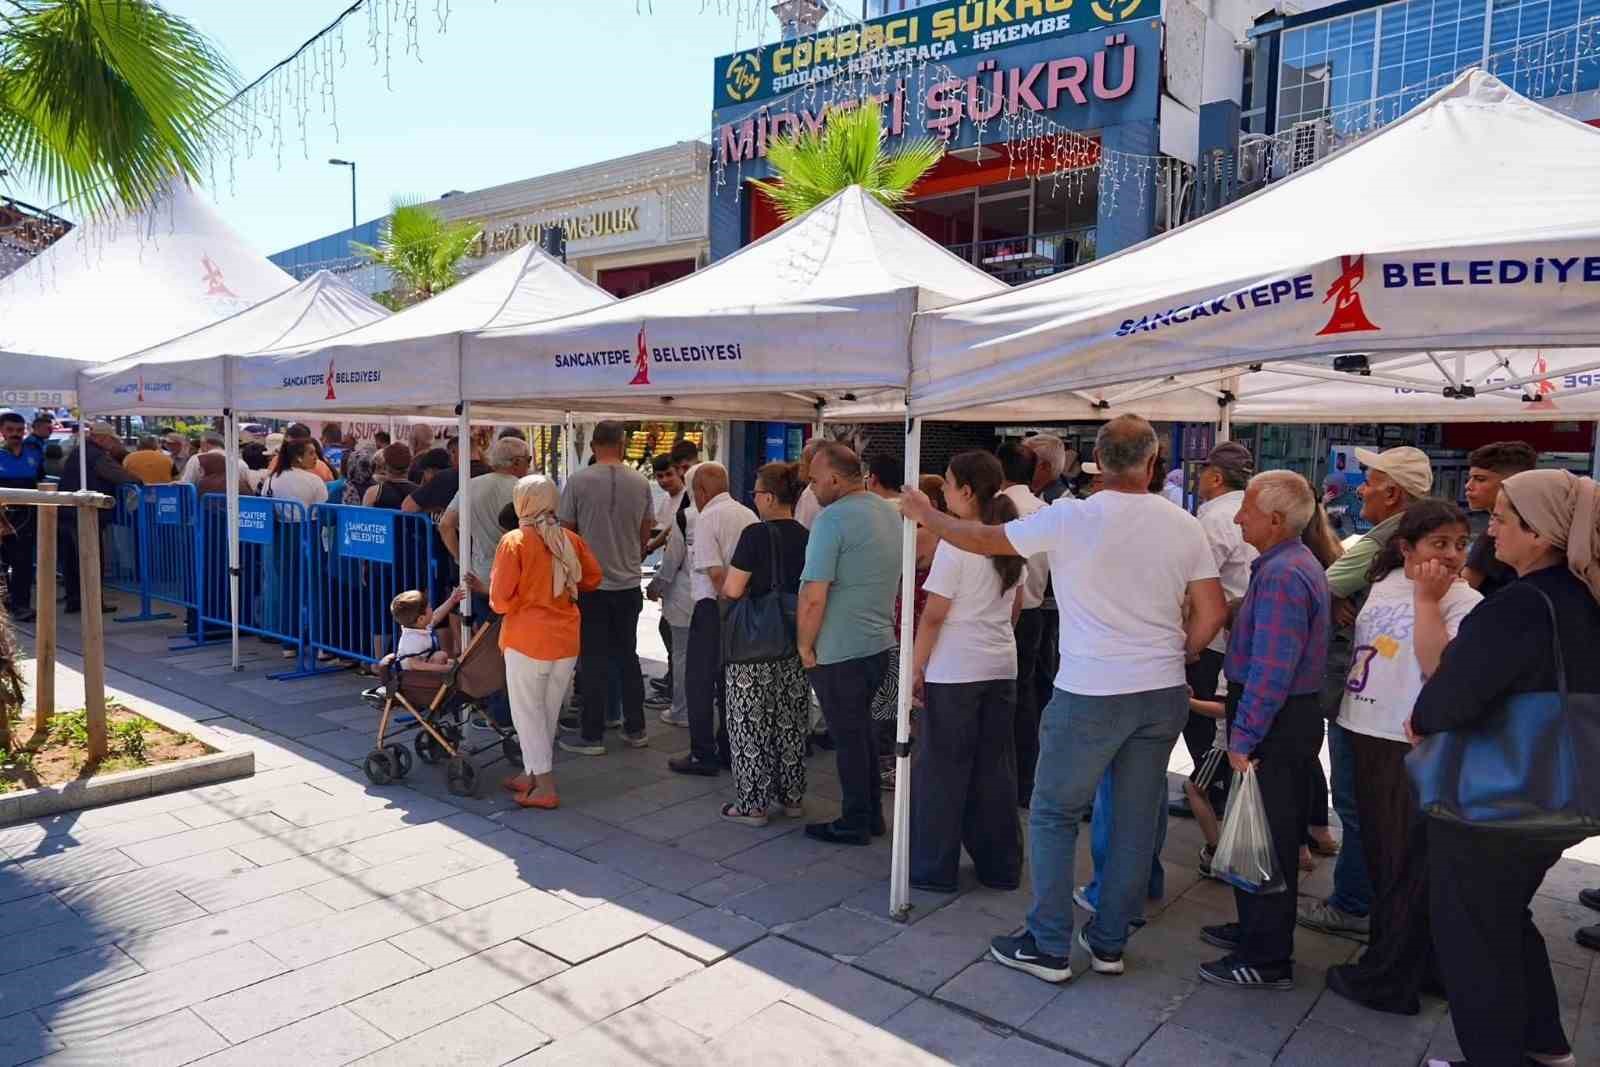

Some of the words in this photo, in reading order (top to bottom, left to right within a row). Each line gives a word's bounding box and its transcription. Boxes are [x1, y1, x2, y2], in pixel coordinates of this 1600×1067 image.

[972, 14, 1070, 50] İŞKEMBE
[926, 33, 1136, 141] ŞÜKRÜ
[1116, 274, 1315, 337] SANCAKTEPE
[555, 349, 631, 368] SANCAKTEPE
[653, 343, 742, 363] BELEDİYESİ
[283, 374, 325, 387] SANCAKTEPE
[336, 370, 381, 384] BELEDİYESİ
